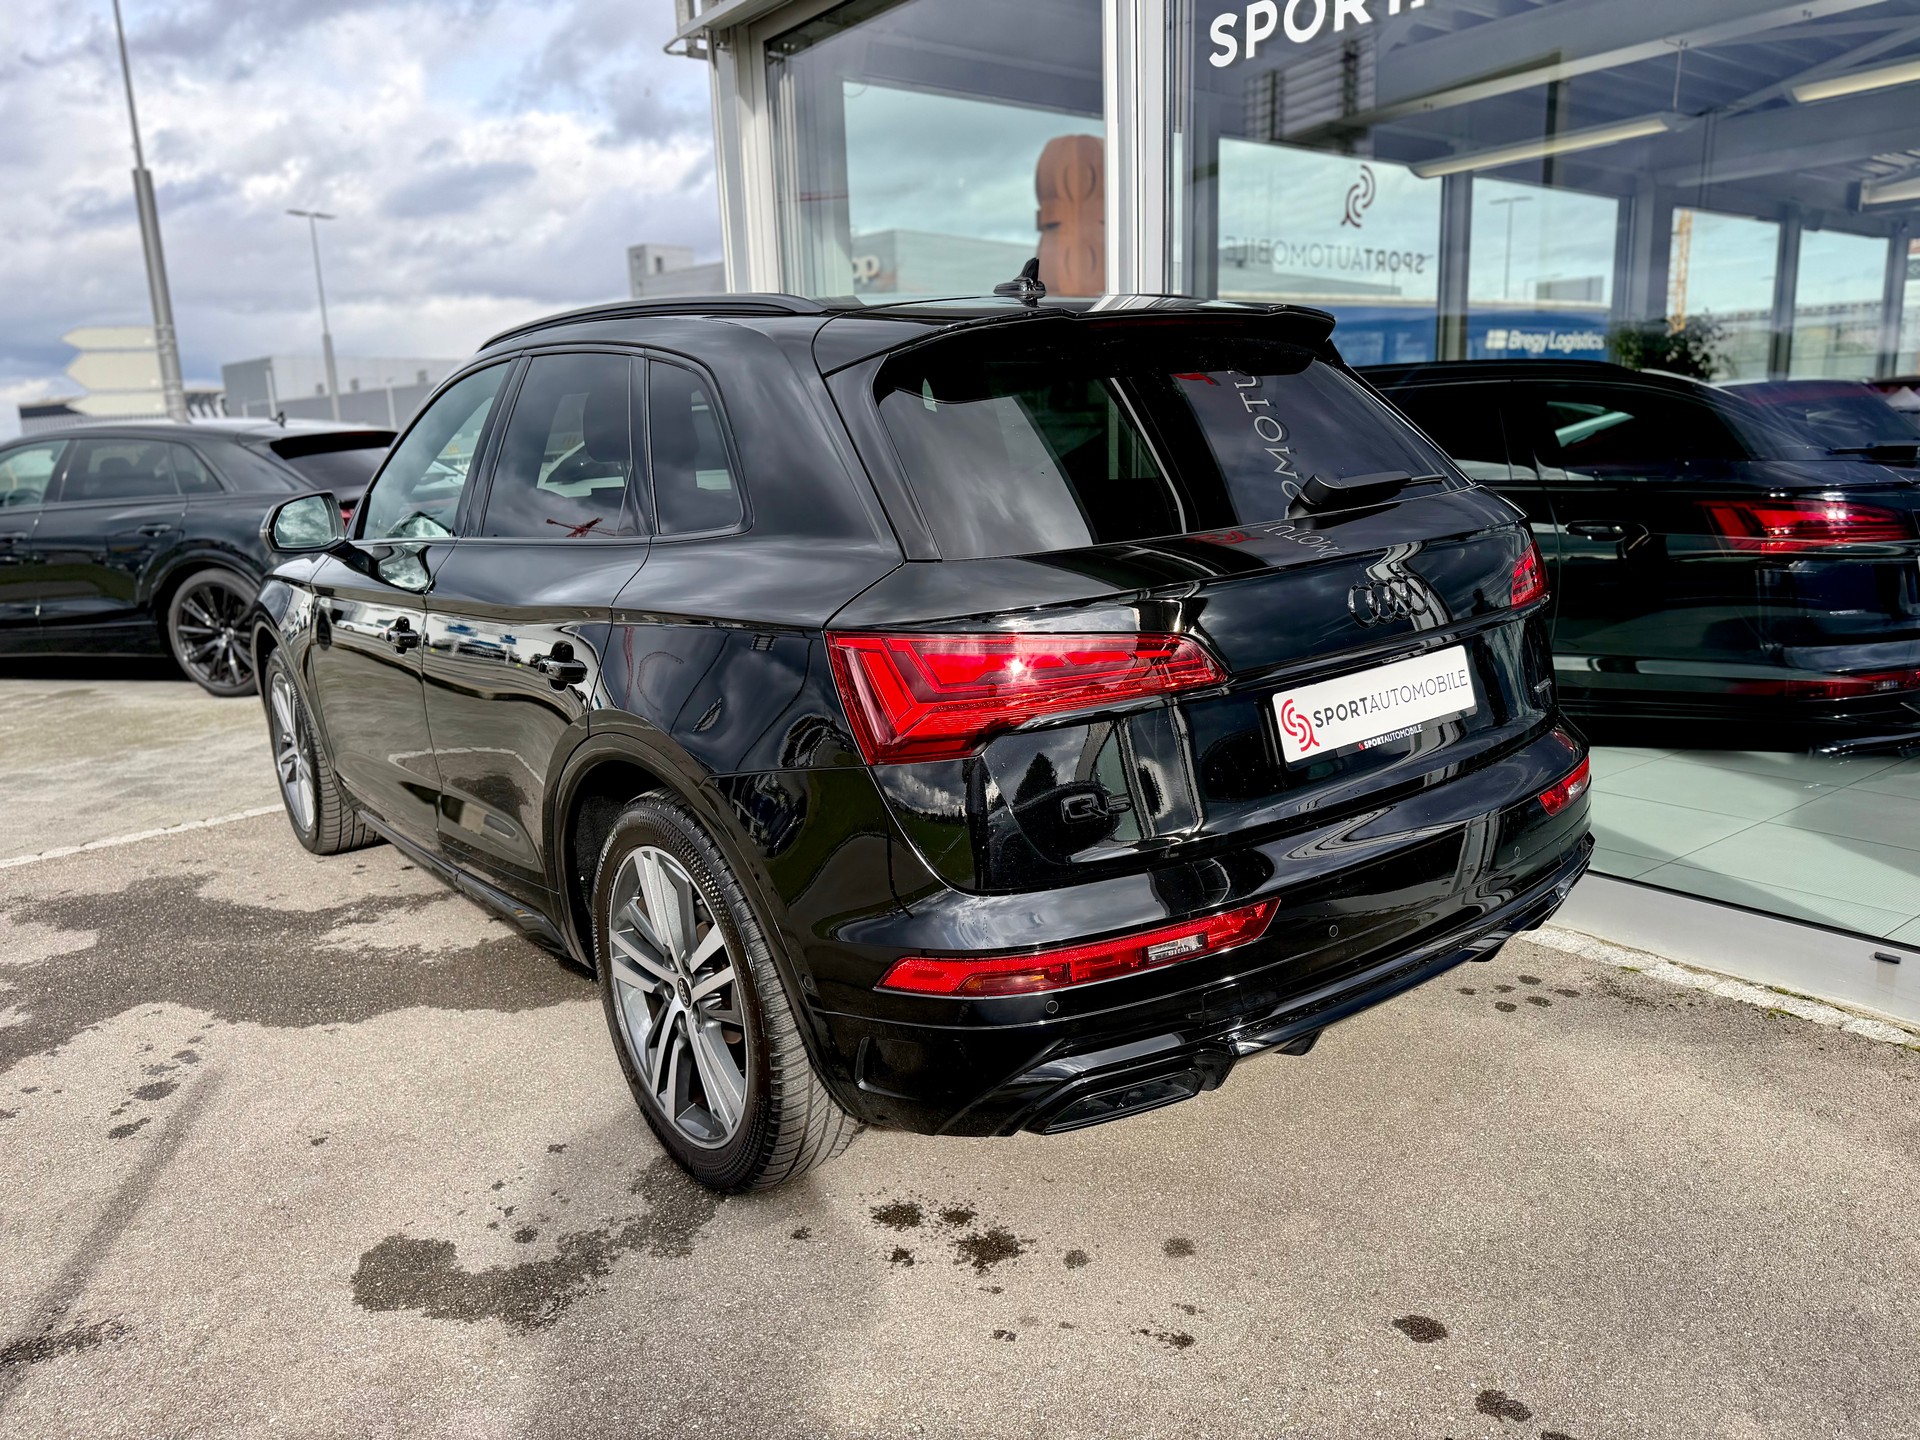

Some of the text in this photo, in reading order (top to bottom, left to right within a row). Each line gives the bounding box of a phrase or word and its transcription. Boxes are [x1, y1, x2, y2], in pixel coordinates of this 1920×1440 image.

[1548, 330, 1605, 353] Logistics
[1313, 669, 1468, 728] SPORTAUTOMOBILE
[1364, 724, 1423, 749] SPORTAUTOMOBILE
[1061, 792, 1131, 824] Q5
